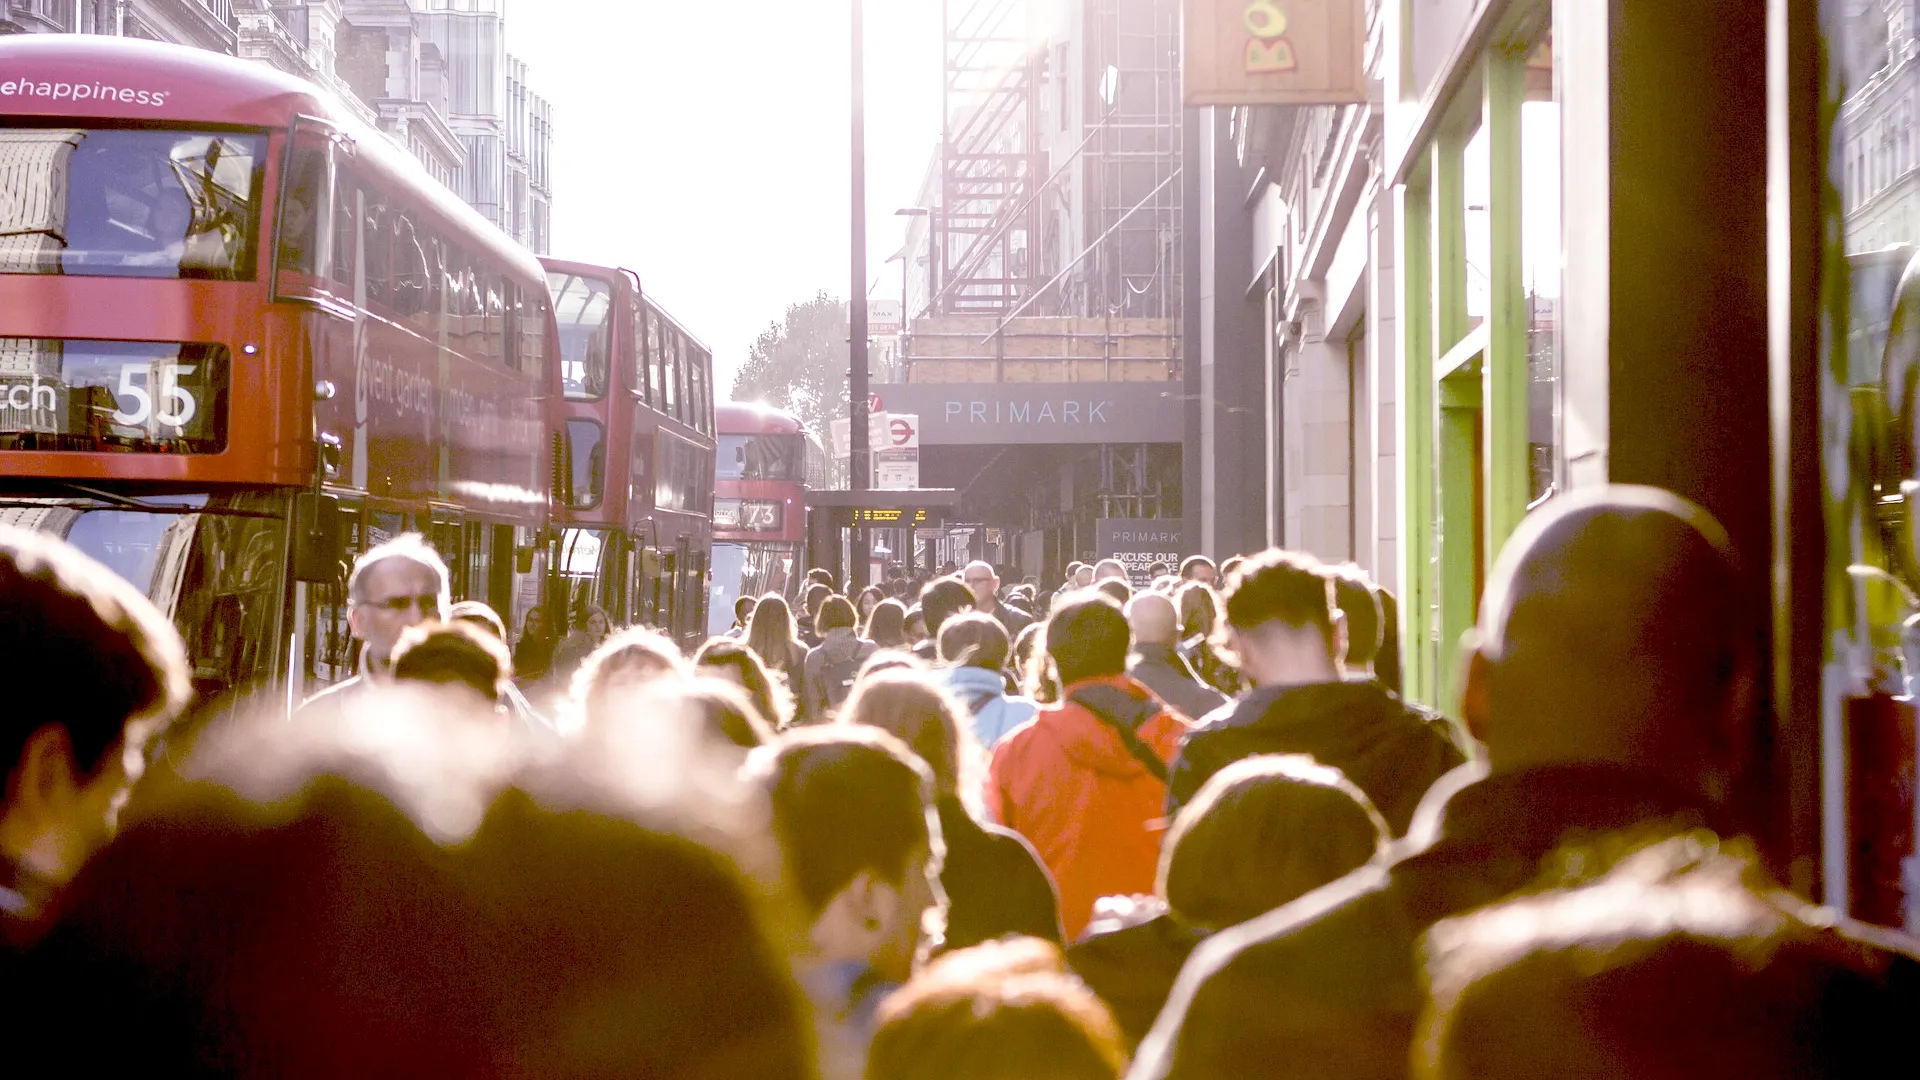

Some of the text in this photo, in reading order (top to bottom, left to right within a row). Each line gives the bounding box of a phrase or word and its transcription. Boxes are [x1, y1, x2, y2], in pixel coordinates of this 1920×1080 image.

[112, 363, 197, 427] 55
[944, 400, 1107, 423] PRIMARK
[748, 504, 775, 525] 73
[1112, 531, 1179, 542] PRIMARK
[1113, 552, 1178, 562] EXCUSE OUR
